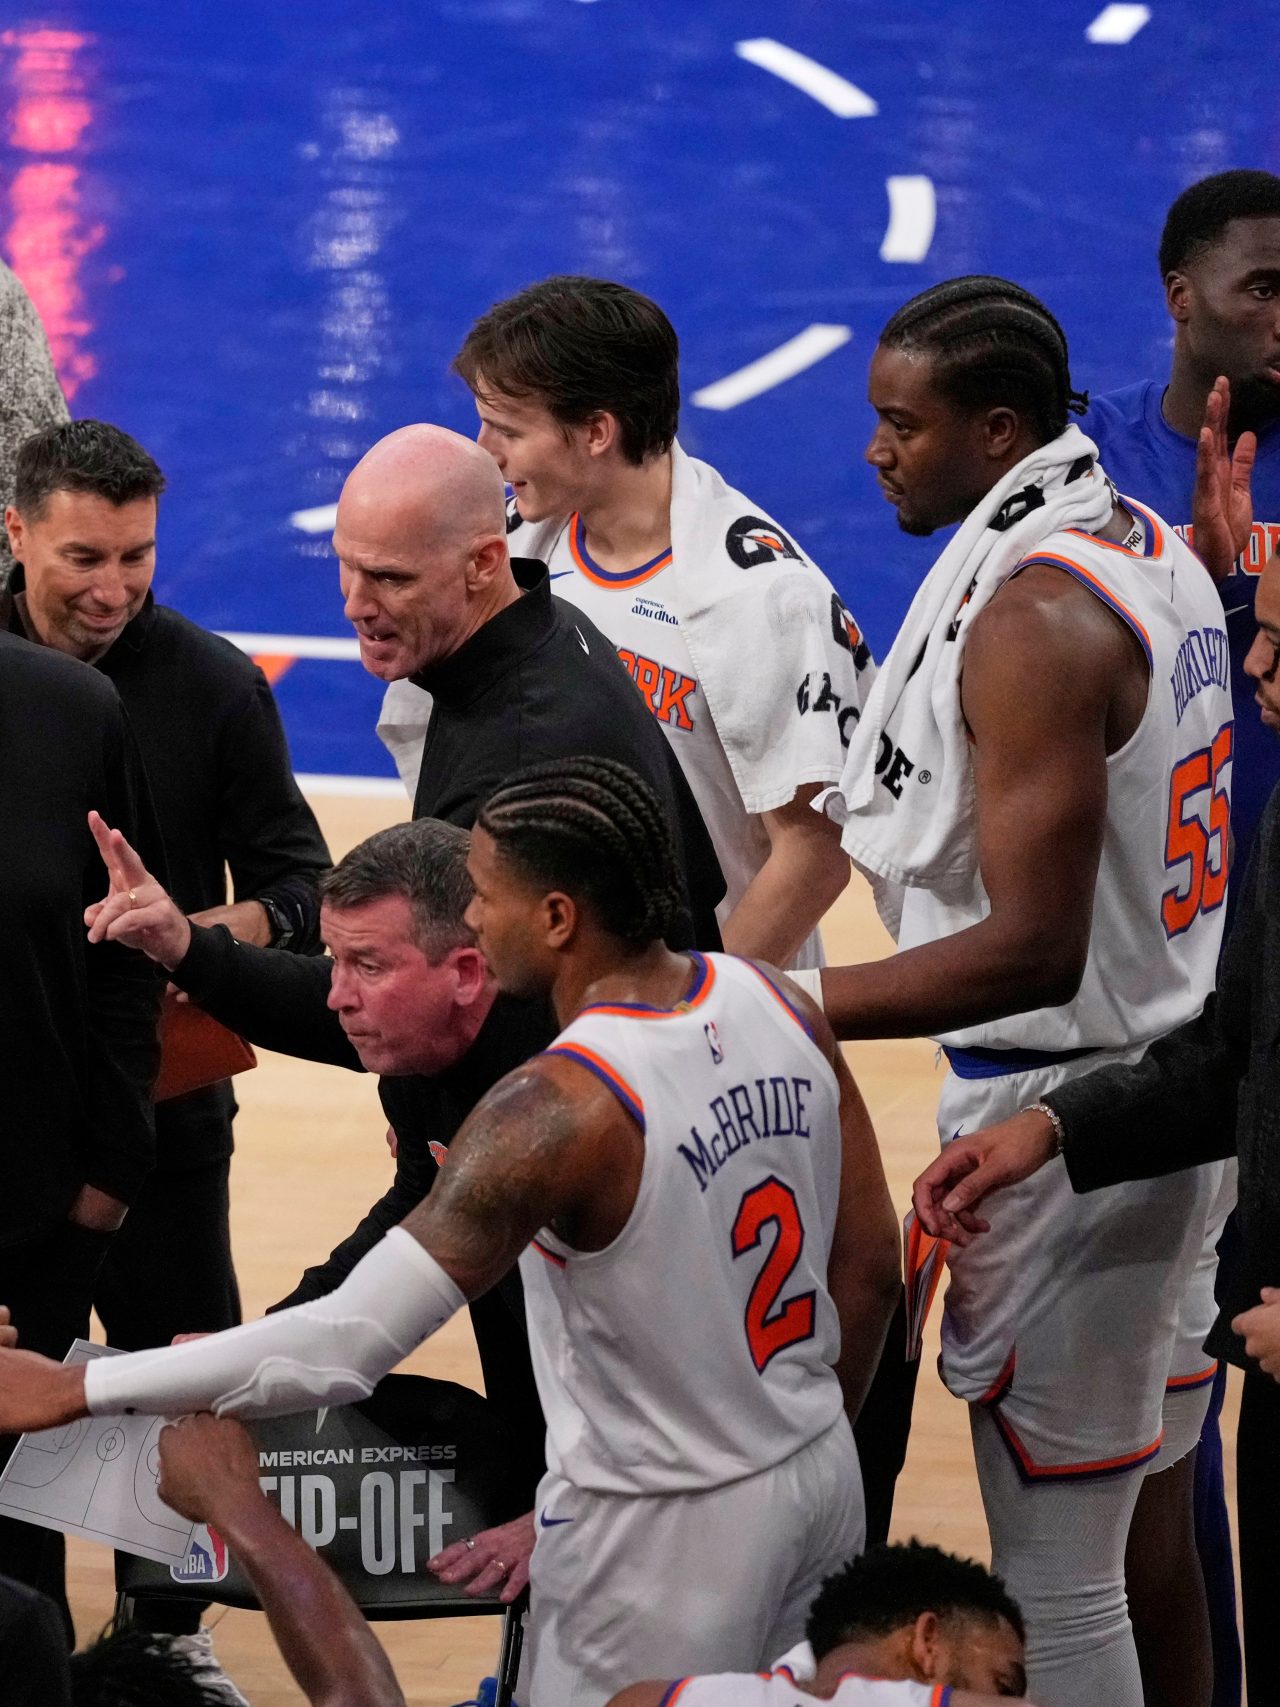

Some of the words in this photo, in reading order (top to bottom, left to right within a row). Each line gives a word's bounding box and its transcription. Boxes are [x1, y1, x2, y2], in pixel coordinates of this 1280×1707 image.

[631, 604, 654, 618] abu
[635, 597, 665, 609] experience
[1161, 720, 1235, 941] 55
[677, 1076, 813, 1192] McBRIDE
[730, 1174, 817, 1377] 2
[258, 1449, 354, 1468] MERICAN
[361, 1445, 457, 1464] EXPRESS
